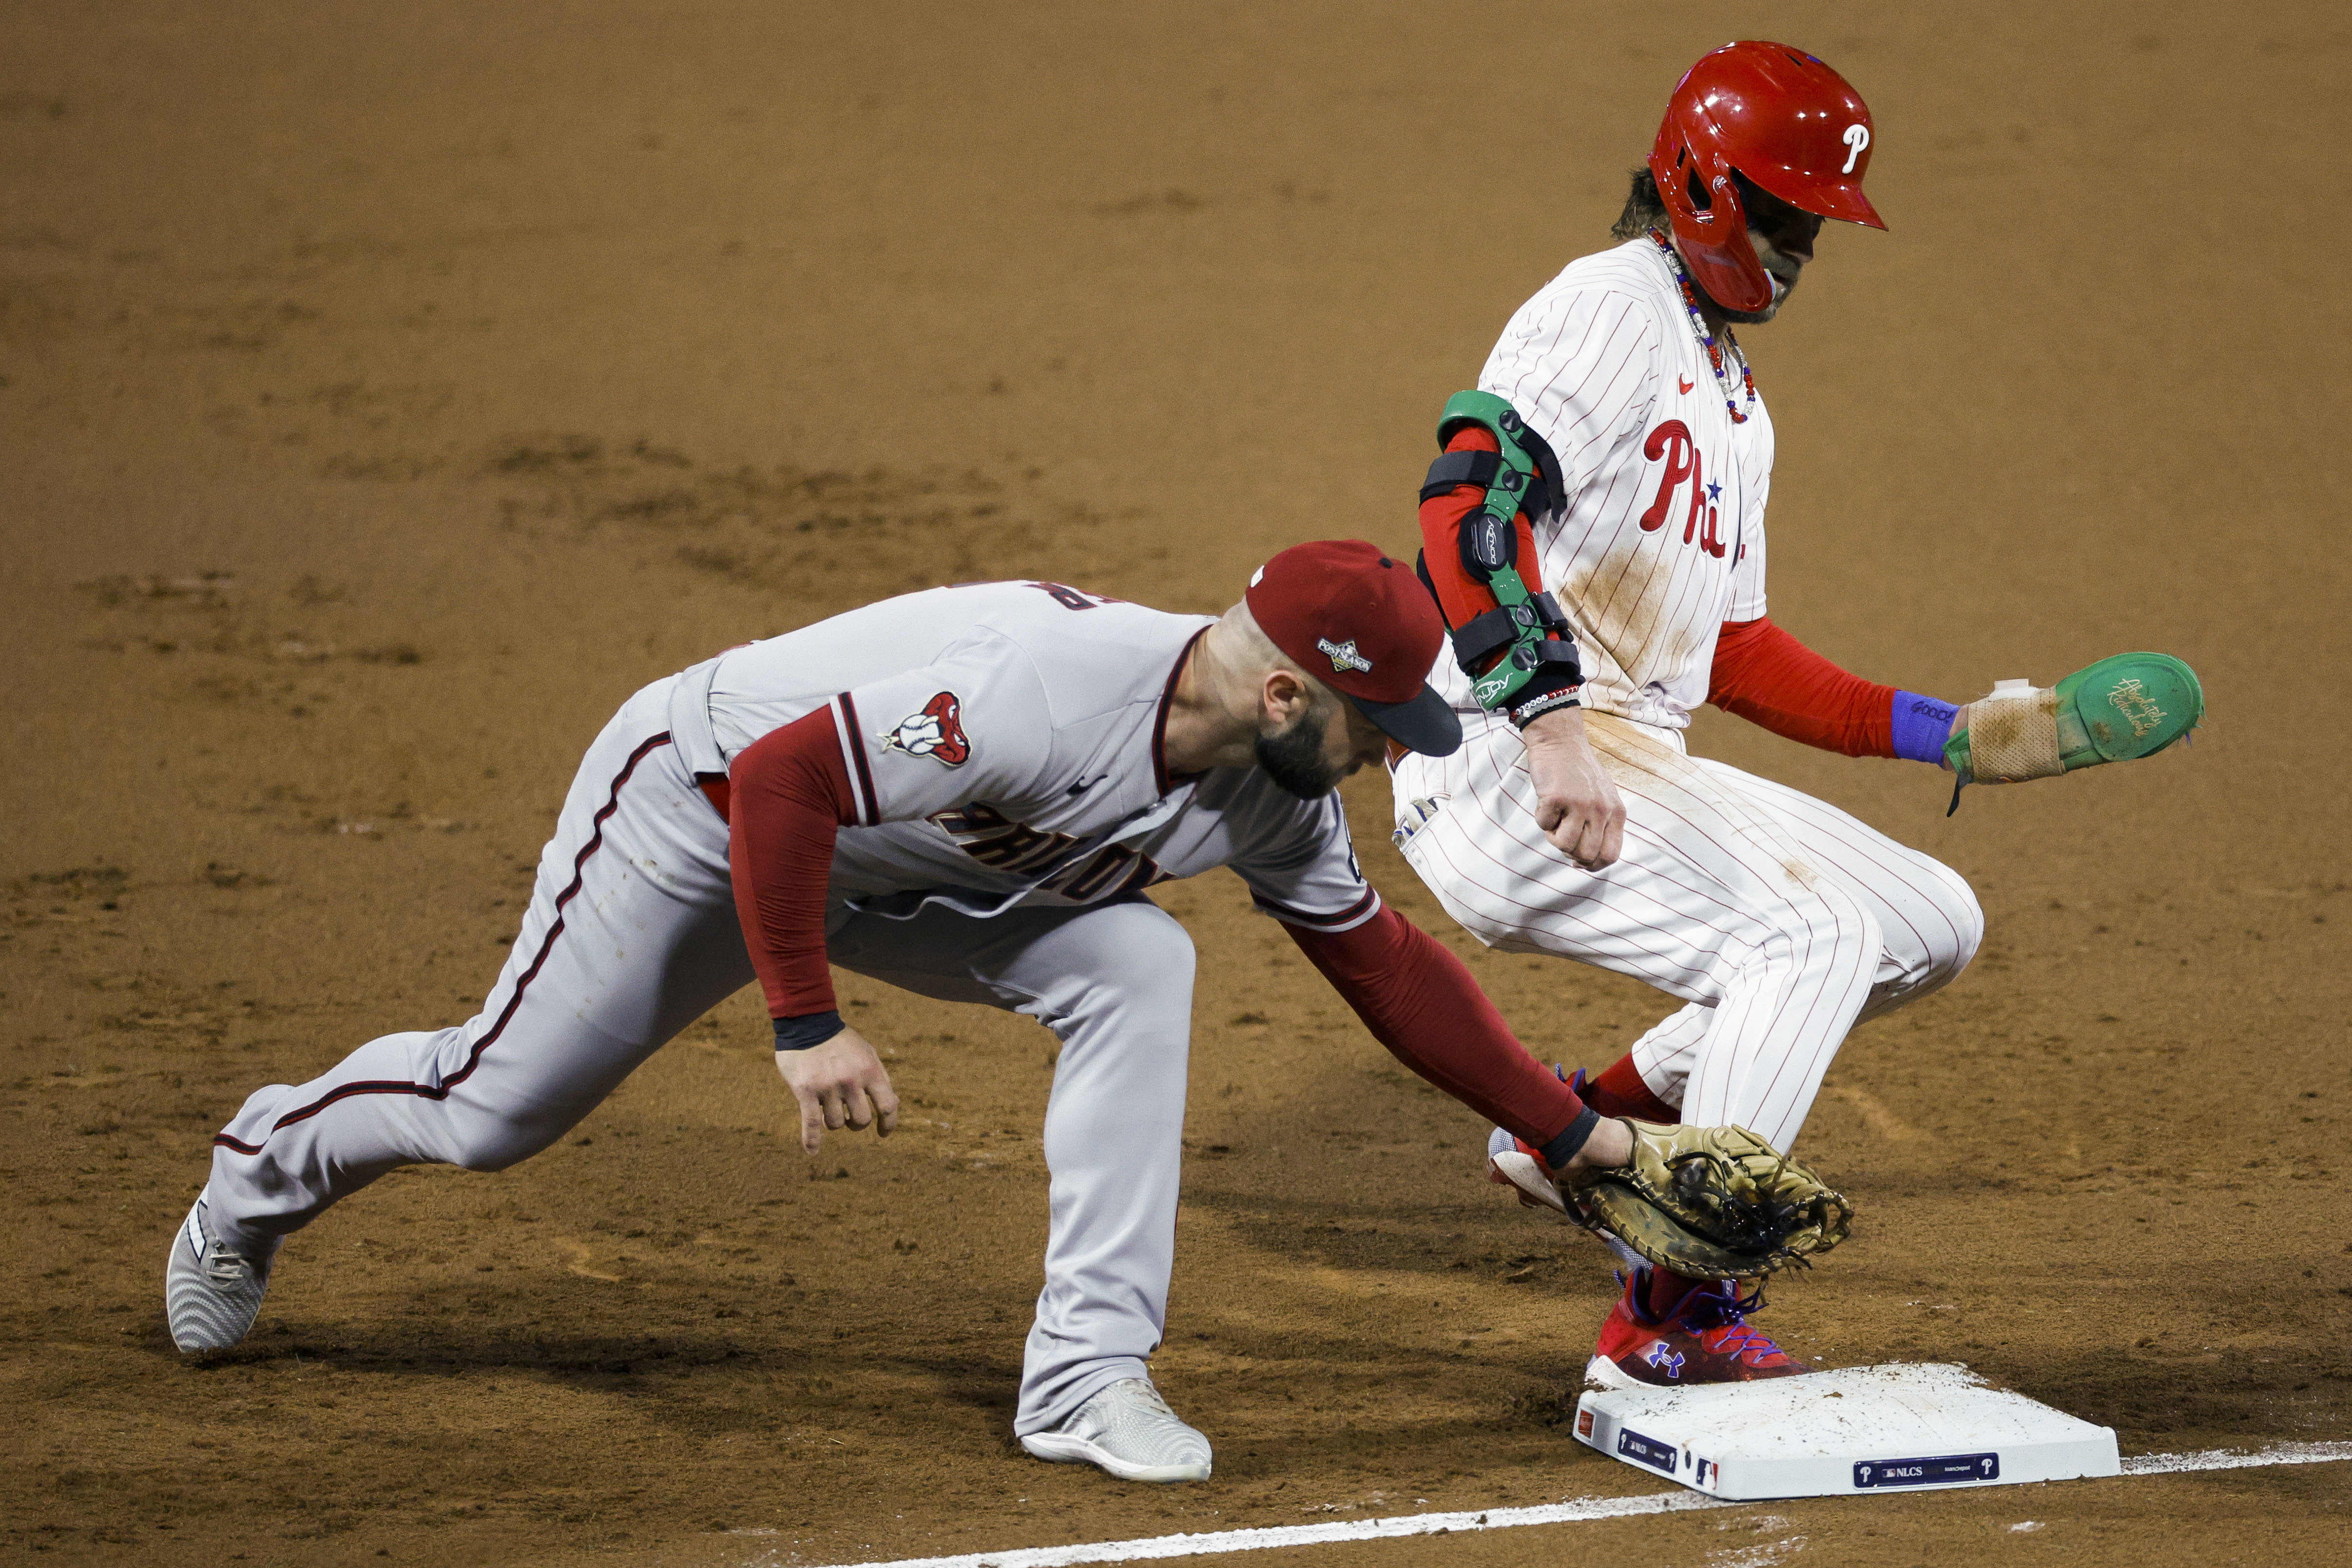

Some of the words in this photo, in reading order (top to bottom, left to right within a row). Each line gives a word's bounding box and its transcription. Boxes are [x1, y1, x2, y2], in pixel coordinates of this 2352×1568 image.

[1842, 124, 1870, 174] P
[1486, 518, 1497, 564] DONJOY
[1319, 641, 1371, 671] POSTSEASON
[1860, 1466, 1871, 1483] P
[1896, 1467, 1923, 1477] NLCS
[1981, 1458, 1993, 1475] P
